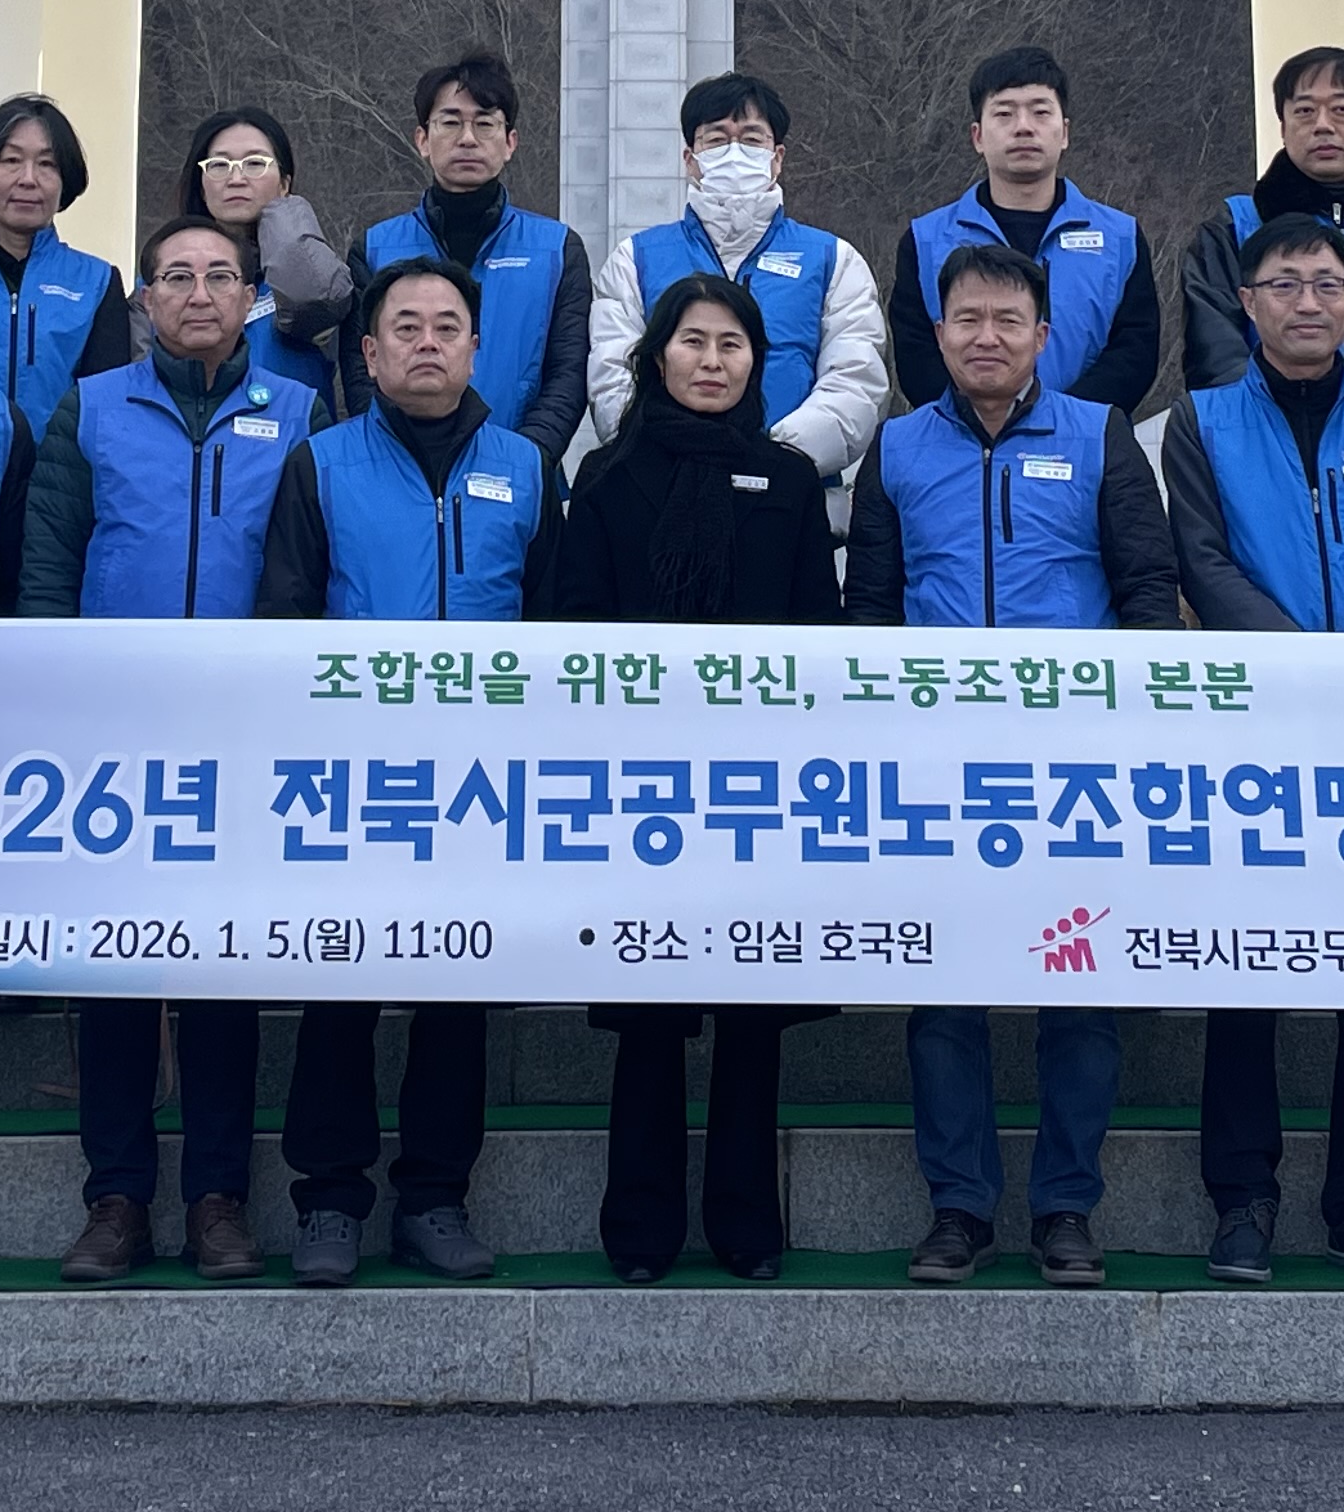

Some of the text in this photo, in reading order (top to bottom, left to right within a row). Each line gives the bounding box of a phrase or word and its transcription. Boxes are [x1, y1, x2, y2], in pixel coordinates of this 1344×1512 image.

[310, 649, 1255, 713] 조합원을 위한 헌신, 노동조합의 본분
[89, 920, 200, 961] 2026.
[384, 920, 494, 961] 11:00
[611, 920, 690, 964] 장소
[727, 920, 804, 964] 임실
[819, 920, 934, 965] 호국원
